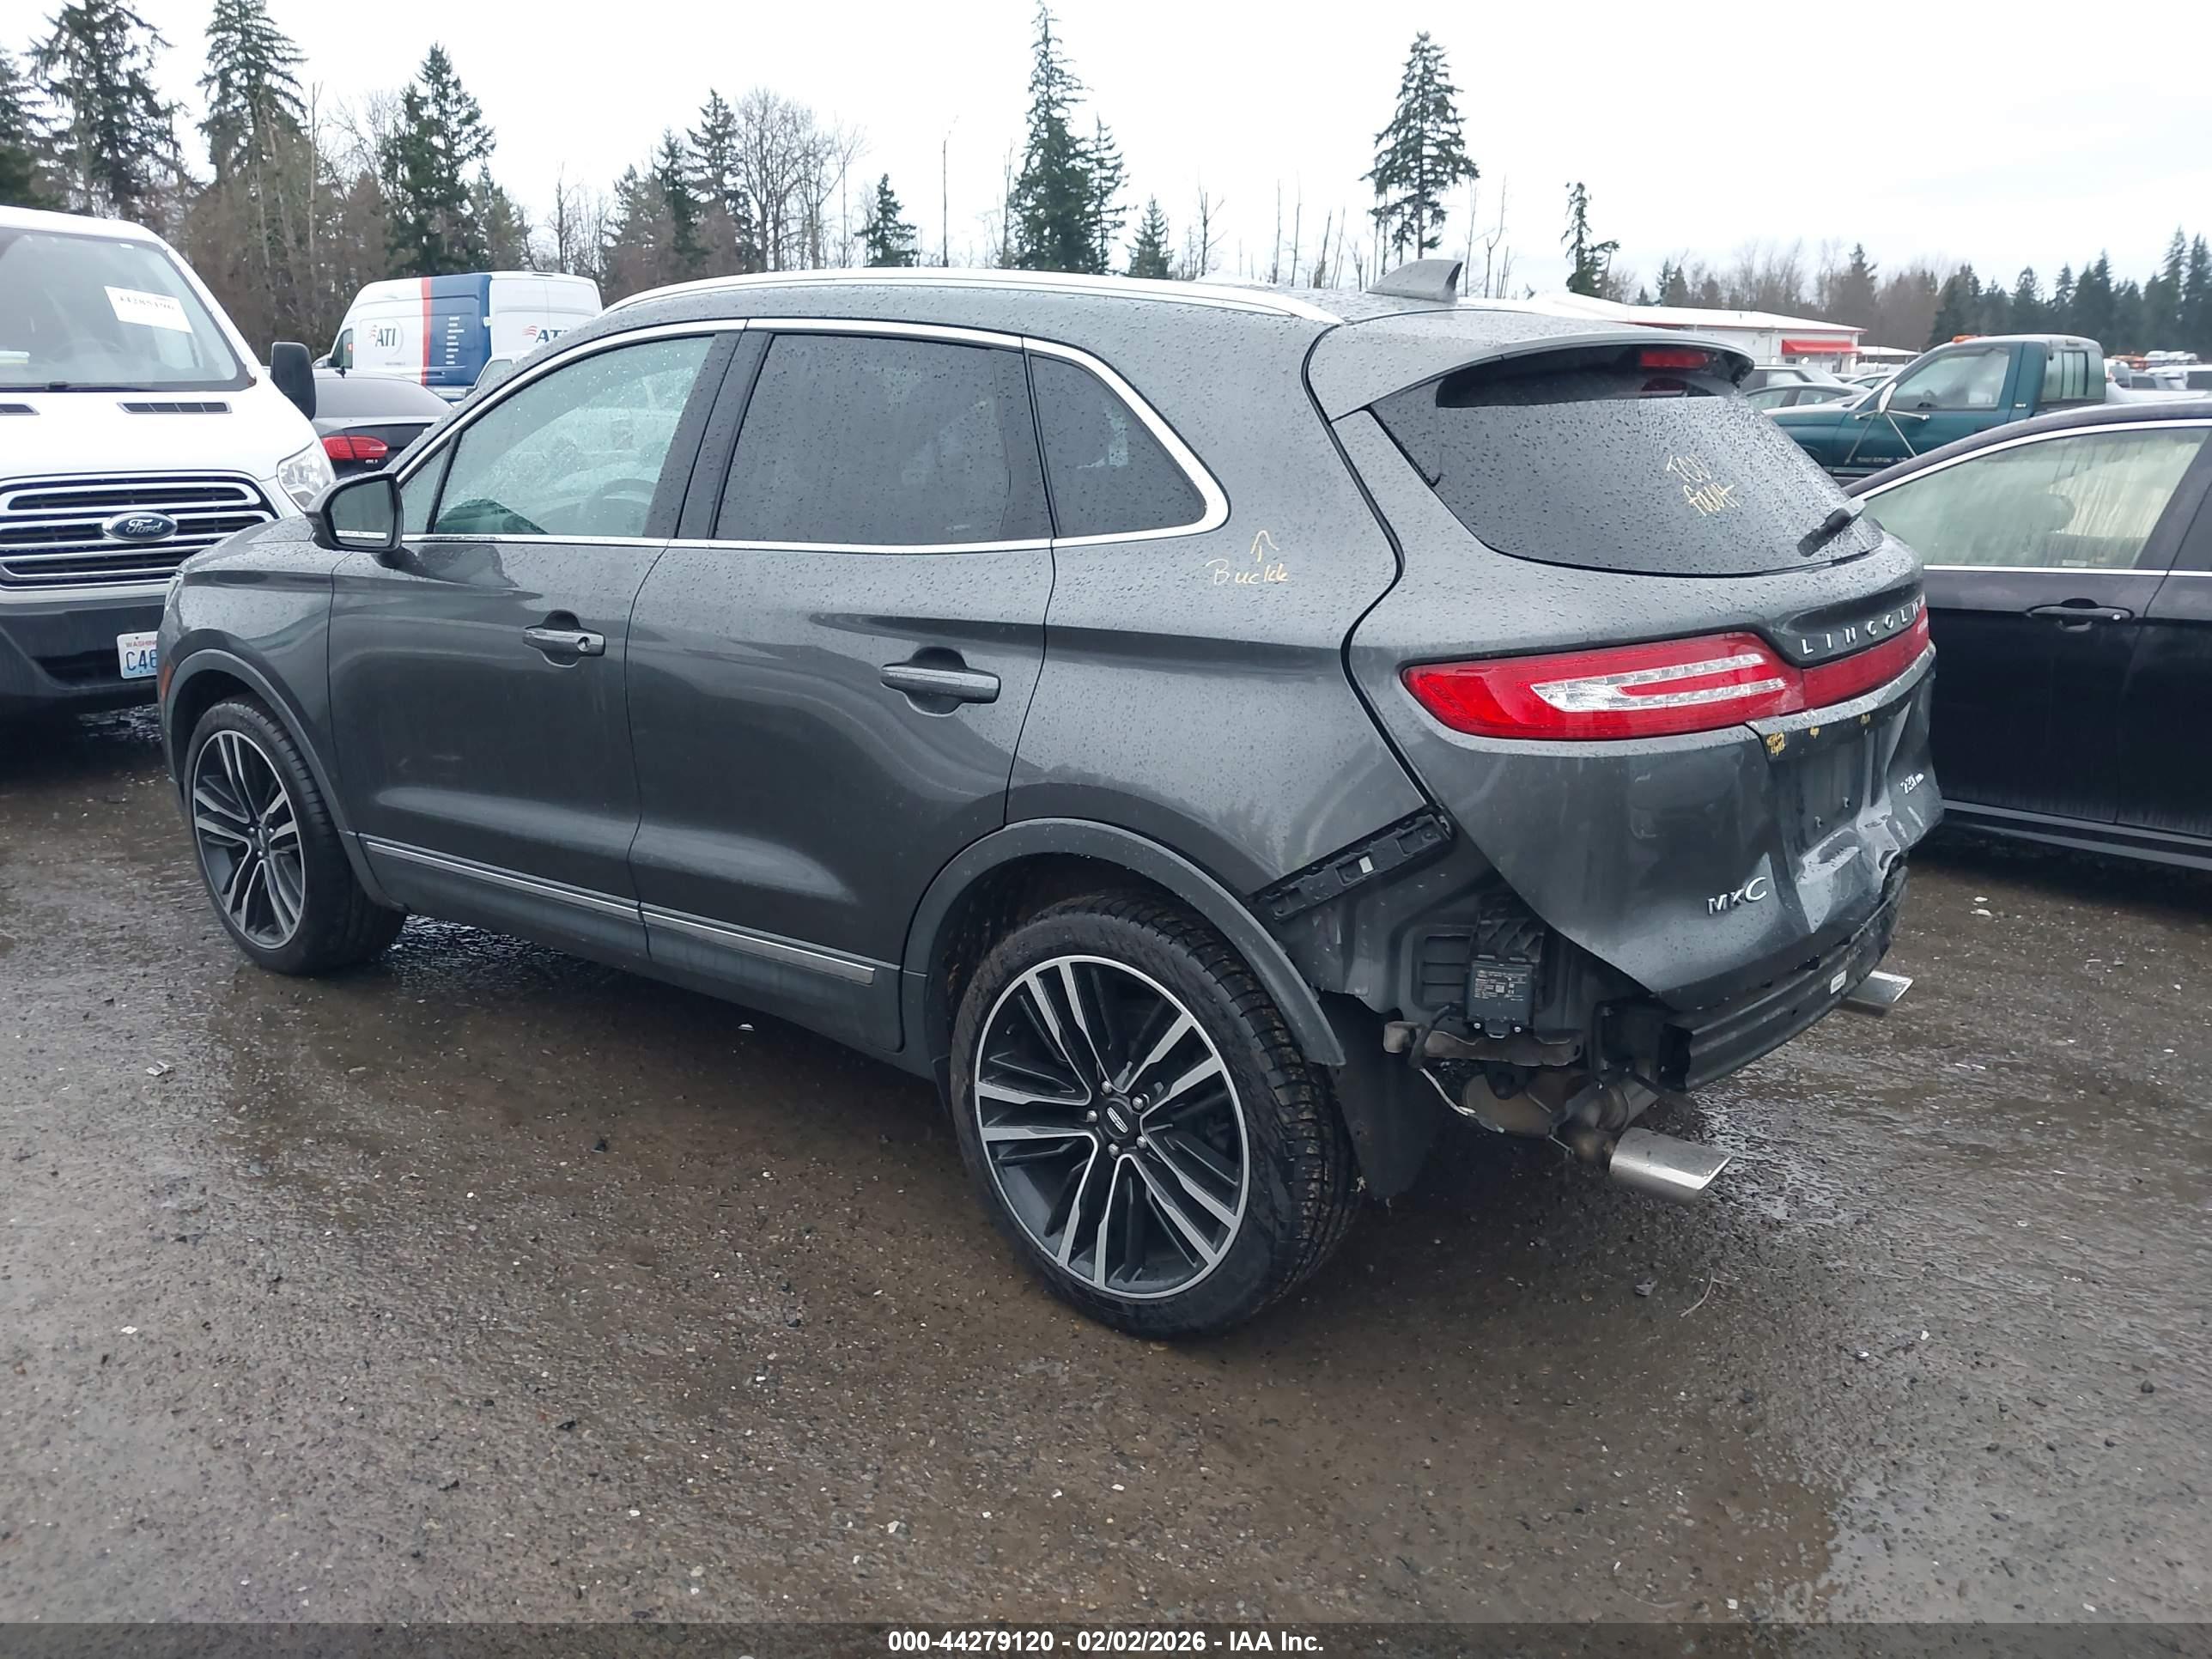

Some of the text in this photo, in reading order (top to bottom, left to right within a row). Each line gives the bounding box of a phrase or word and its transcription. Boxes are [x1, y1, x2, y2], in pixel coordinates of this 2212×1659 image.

[374, 327, 397, 347] ATI
[535, 329, 568, 343] AT
[125, 519, 163, 534] Ford
[1802, 601, 1920, 654] LINCOLN
[1707, 876, 1767, 915] MKC
